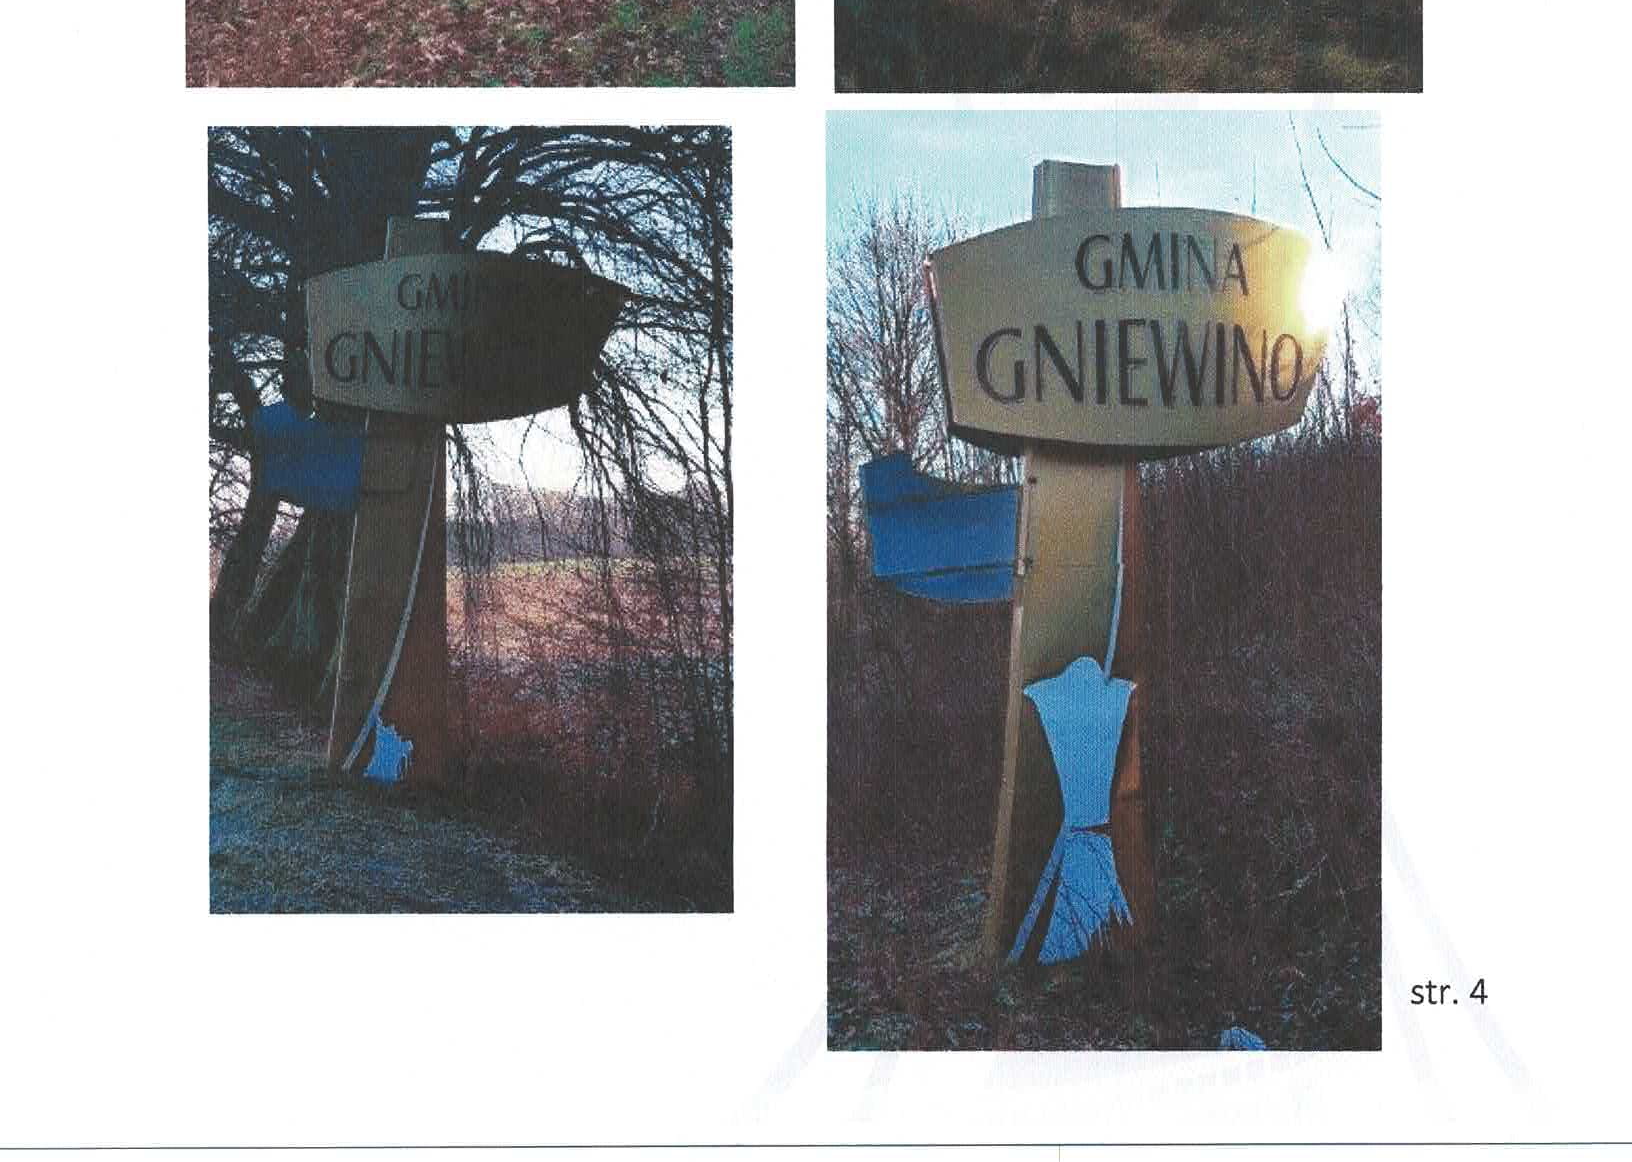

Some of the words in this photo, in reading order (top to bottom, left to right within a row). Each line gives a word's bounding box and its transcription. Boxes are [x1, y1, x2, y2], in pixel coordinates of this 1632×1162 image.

[1074, 233, 1250, 296] GMINA
[975, 318, 1302, 407] GNIEWINO
[1410, 979, 1458, 1005] str.
[1469, 978, 1488, 1005] 4
